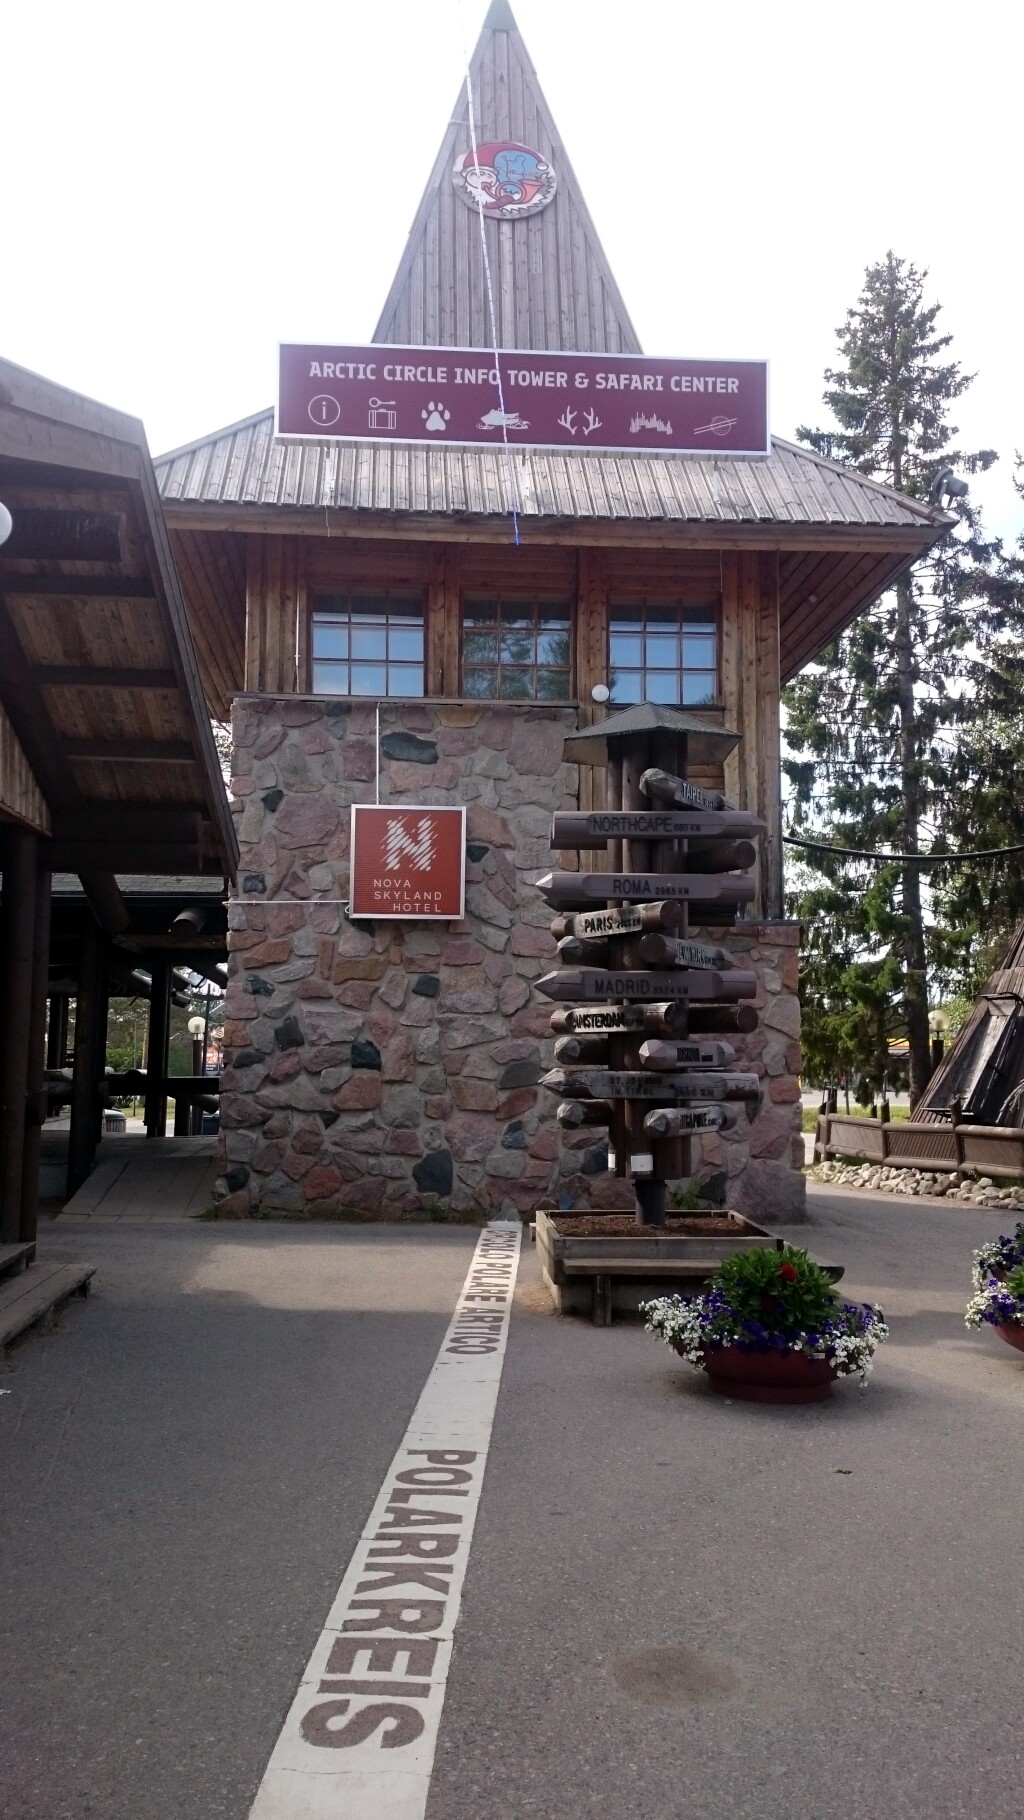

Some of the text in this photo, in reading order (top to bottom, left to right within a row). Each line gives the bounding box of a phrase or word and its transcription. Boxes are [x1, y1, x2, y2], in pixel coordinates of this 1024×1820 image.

[309, 362, 740, 393] ARCTIC CIRCLE INFO TOWER & SAFARI CENTER
[682, 782, 703, 804] TAIPEI
[593, 816, 673, 832] NORTHCAPE
[373, 879, 411, 888] NOVA
[613, 879, 651, 894] ROMA
[678, 886, 690, 895] KM
[374, 890, 442, 900] SKYLAND
[393, 903, 441, 913] HOTEL
[584, 915, 613, 933] PARIS
[595, 979, 650, 995] MADRID
[677, 986, 689, 995] KM
[573, 1012, 626, 1029] AMSTERDAM
[464, 1262, 513, 1303] POLARE
[445, 1306, 505, 1355] ARTICO
[299, 1450, 477, 1749] POLARKREIS
